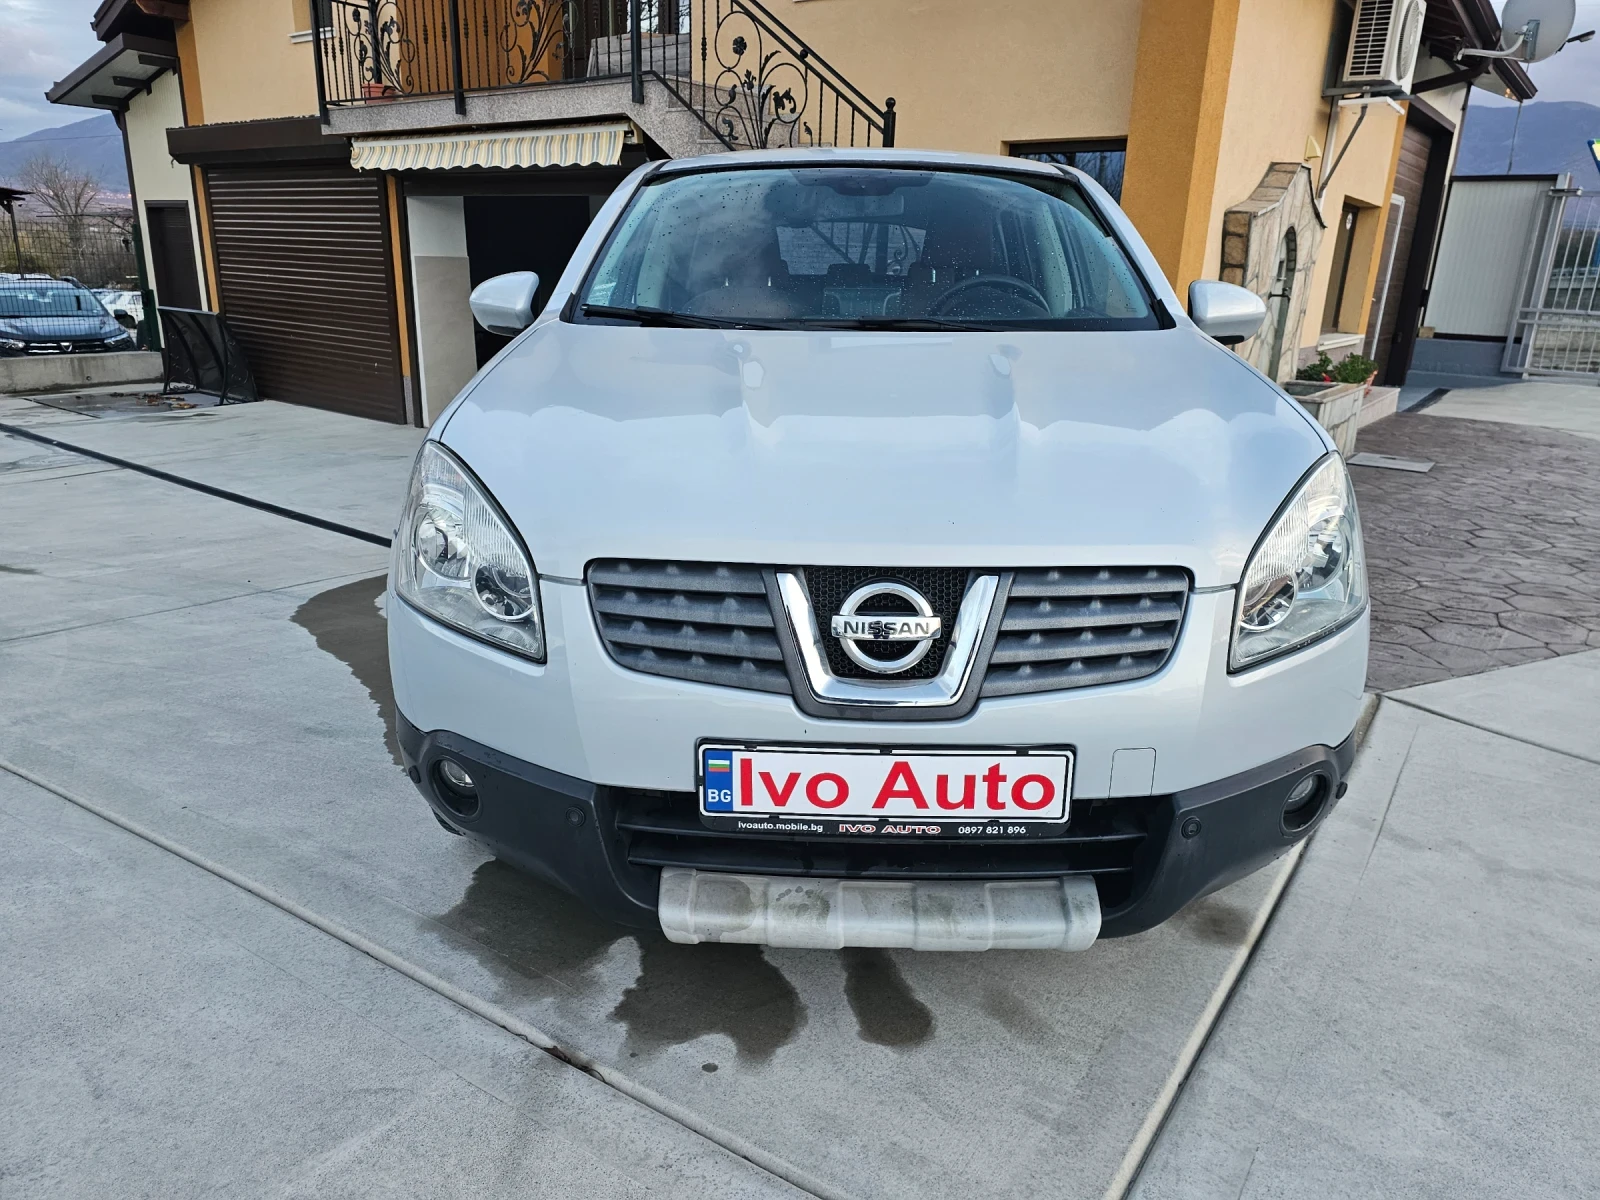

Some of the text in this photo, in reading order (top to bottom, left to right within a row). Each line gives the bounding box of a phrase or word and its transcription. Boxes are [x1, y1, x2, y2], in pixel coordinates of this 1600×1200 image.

[843, 620, 930, 636] NISSAN
[741, 759, 1055, 810] Ivo Auto
[708, 788, 731, 801] BG
[839, 824, 941, 834] IVO AUTO
[958, 826, 1026, 834] 0897 821 896
